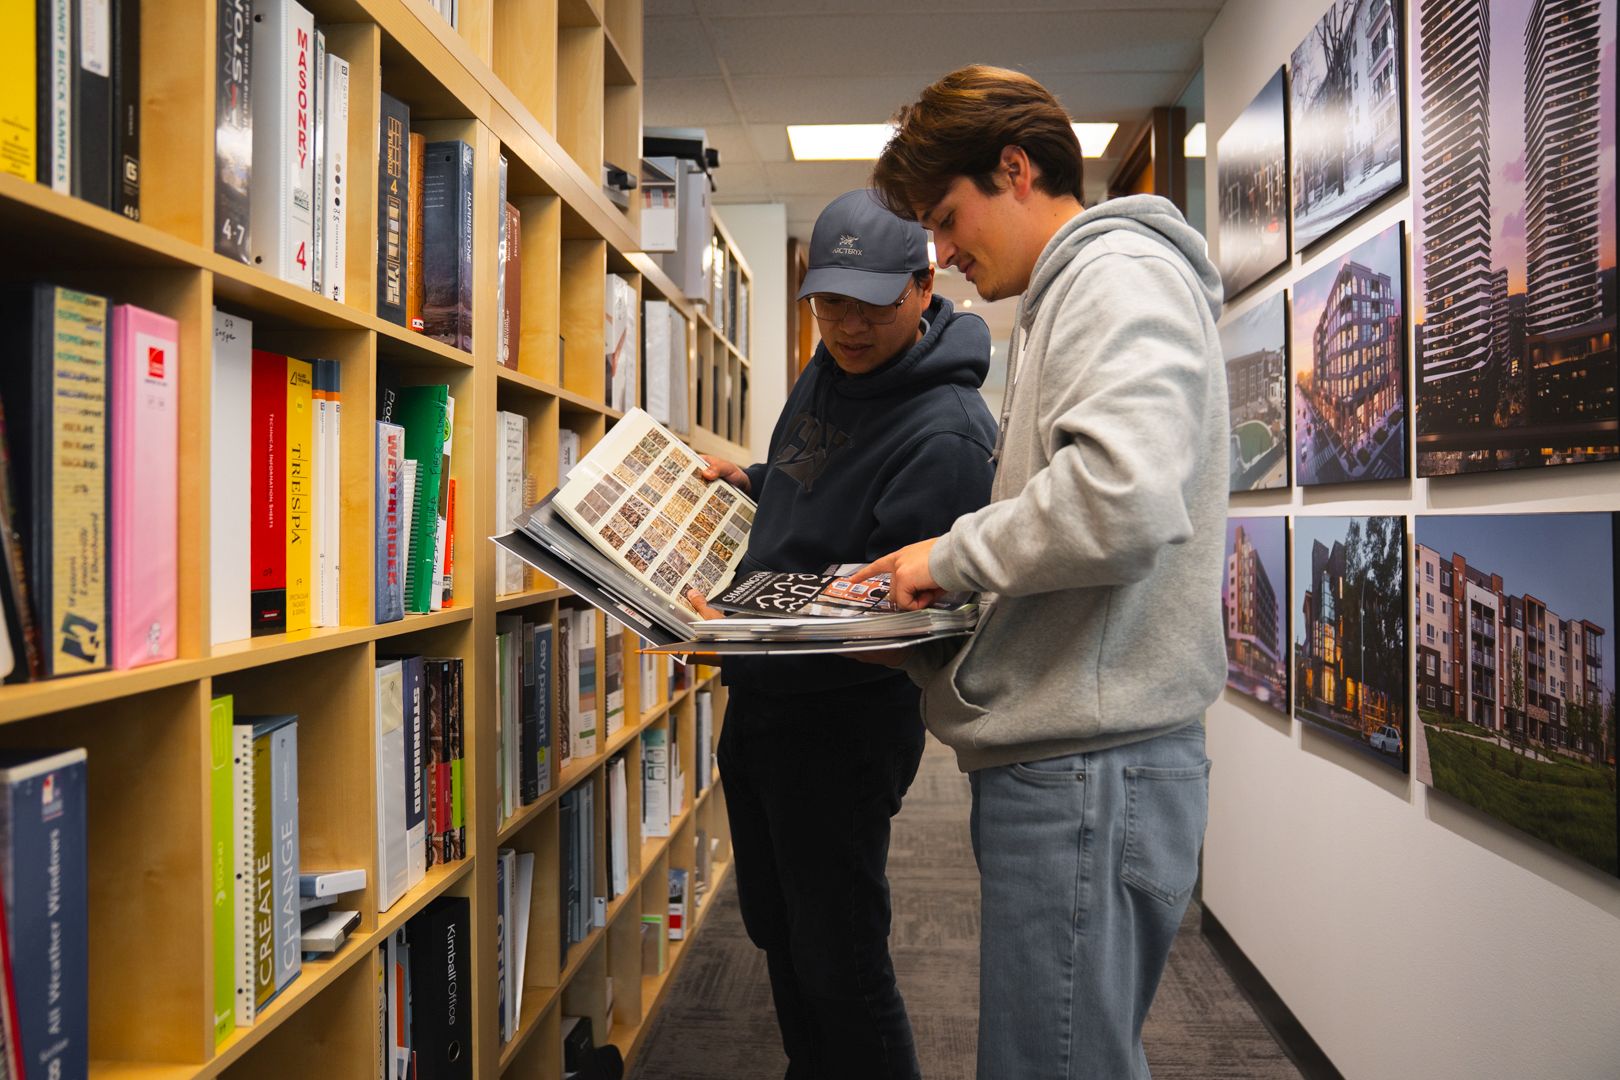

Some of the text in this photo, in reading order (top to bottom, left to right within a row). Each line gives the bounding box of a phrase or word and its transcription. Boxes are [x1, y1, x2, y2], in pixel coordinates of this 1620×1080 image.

[57, 49, 67, 101] BLOCK
[297, 27, 308, 169] MASONRY
[57, 107, 67, 183] SAMPLES
[390, 179, 398, 195] 4
[296, 241, 307, 272] 4
[291, 443, 302, 545] TRESPA
[537, 673, 547, 743] parent
[413, 685, 421, 814] STONHARD
[48, 828, 61, 917] Windows
[281, 819, 295, 972] CHANGE
[259, 851, 273, 986] CREATE
[48, 920, 61, 1005] Weather
[48, 1006, 61, 1035] All
[447, 981, 457, 1026] Office
